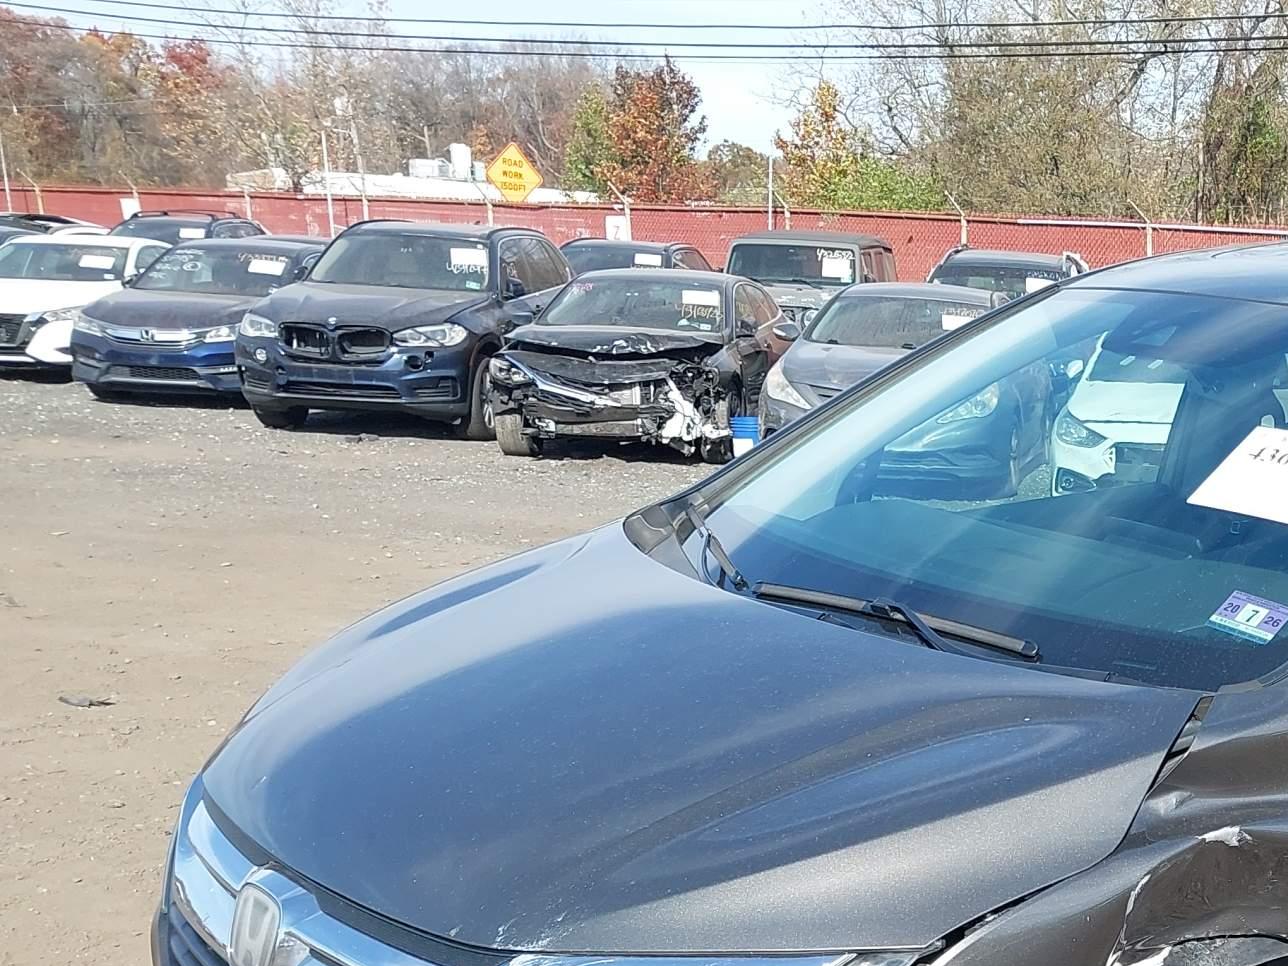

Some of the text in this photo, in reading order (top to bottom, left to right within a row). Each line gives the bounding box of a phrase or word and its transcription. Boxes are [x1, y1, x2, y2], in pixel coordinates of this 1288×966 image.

[502, 157, 524, 168] ROAD
[502, 170, 524, 180] WORK
[500, 181, 526, 192] 1500FT
[1223, 602, 1241, 614] 20
[1245, 609, 1260, 623] 7
[1263, 615, 1282, 628] 26
